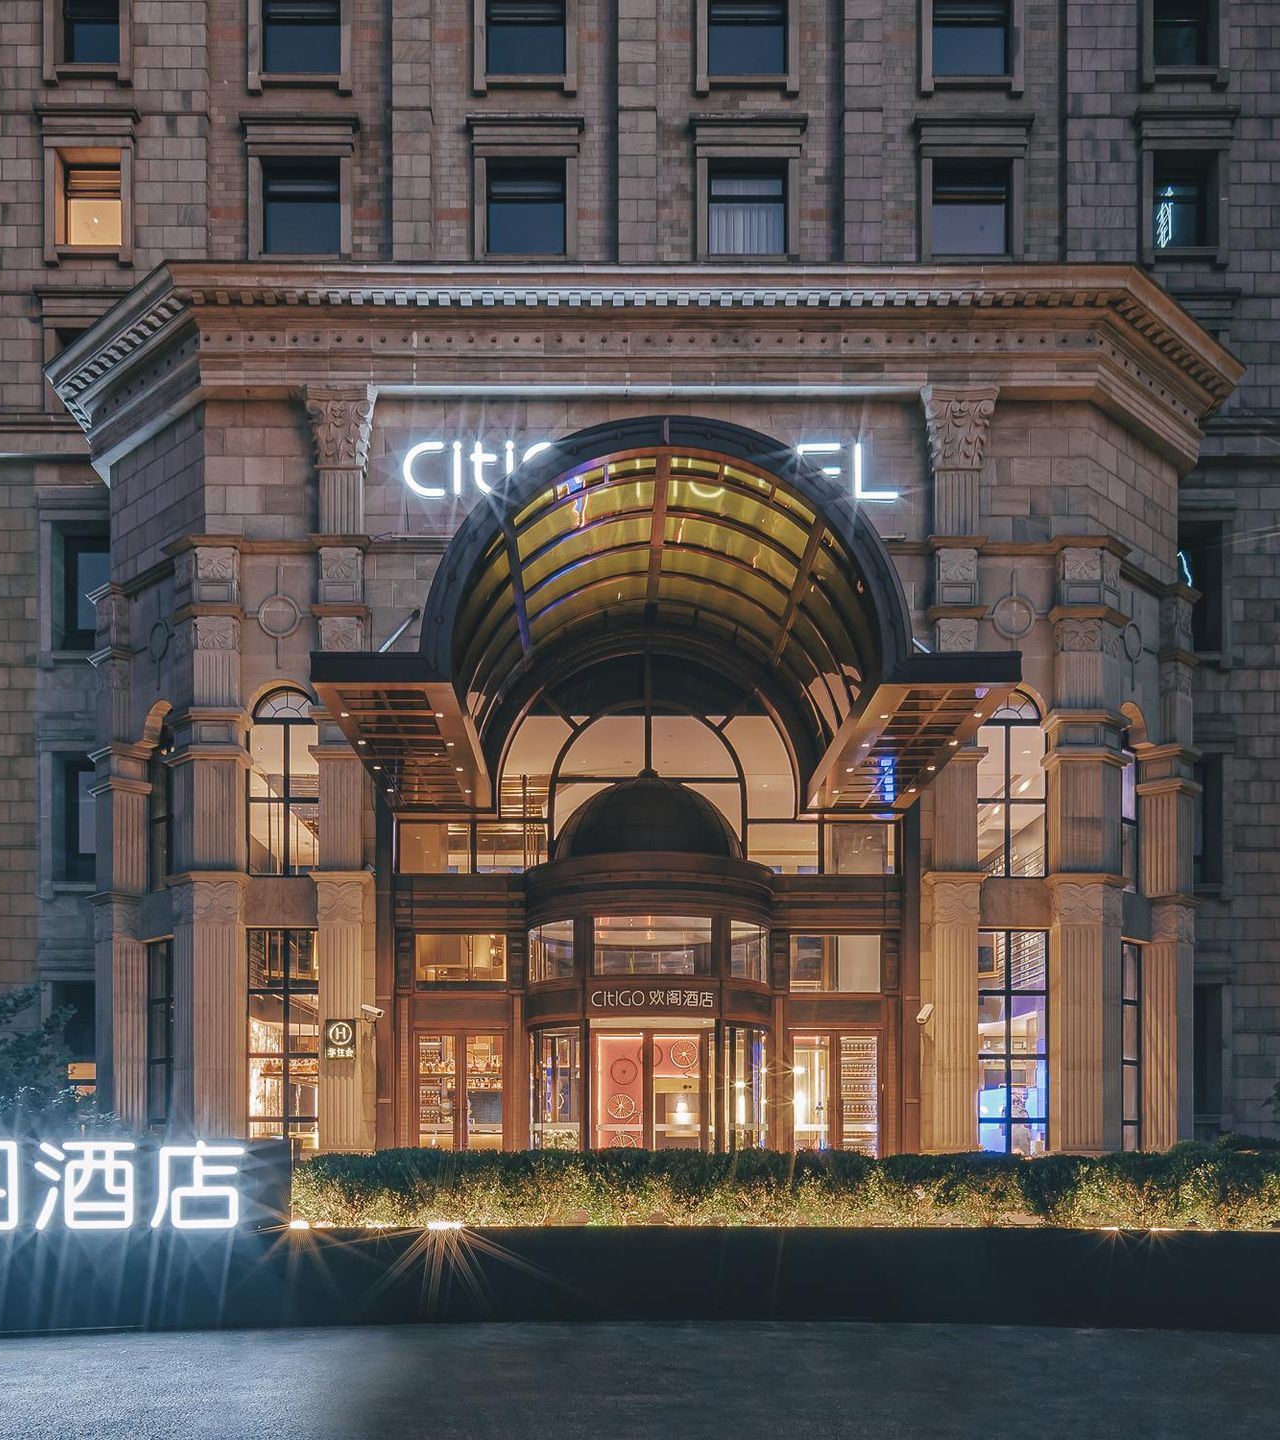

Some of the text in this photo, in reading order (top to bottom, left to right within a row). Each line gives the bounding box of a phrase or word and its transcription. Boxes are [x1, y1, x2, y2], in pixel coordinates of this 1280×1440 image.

[402, 440, 552, 500] Citi
[649, 989, 714, 1008] 欢阁酒店
